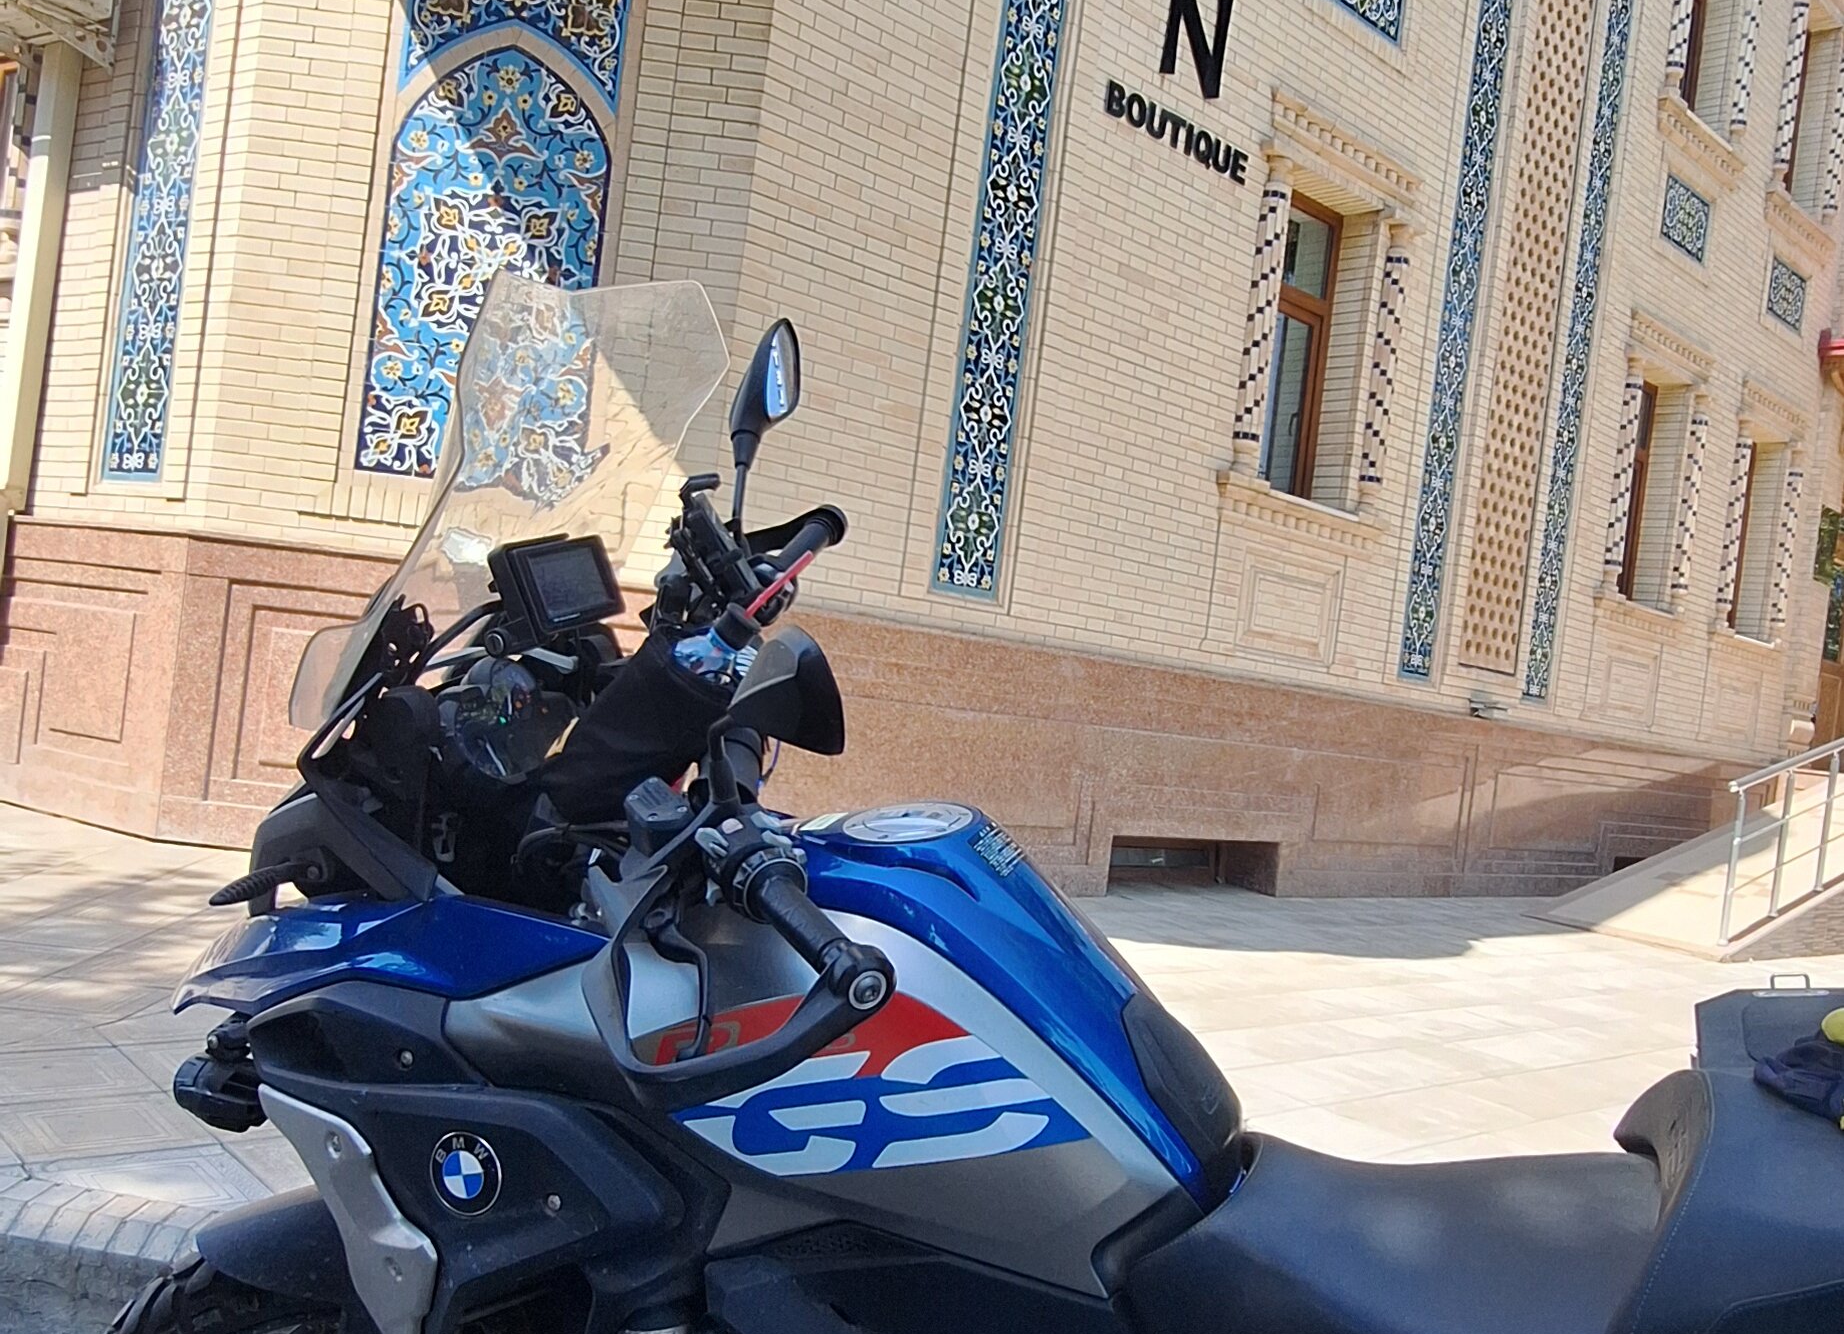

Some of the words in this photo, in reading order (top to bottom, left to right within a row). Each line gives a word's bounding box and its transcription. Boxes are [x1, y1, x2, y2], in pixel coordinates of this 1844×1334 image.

[1105, 79, 1249, 186] BOUTIQUE
[434, 1136, 489, 1164] BMW
[682, 1037, 1056, 1176] GS
